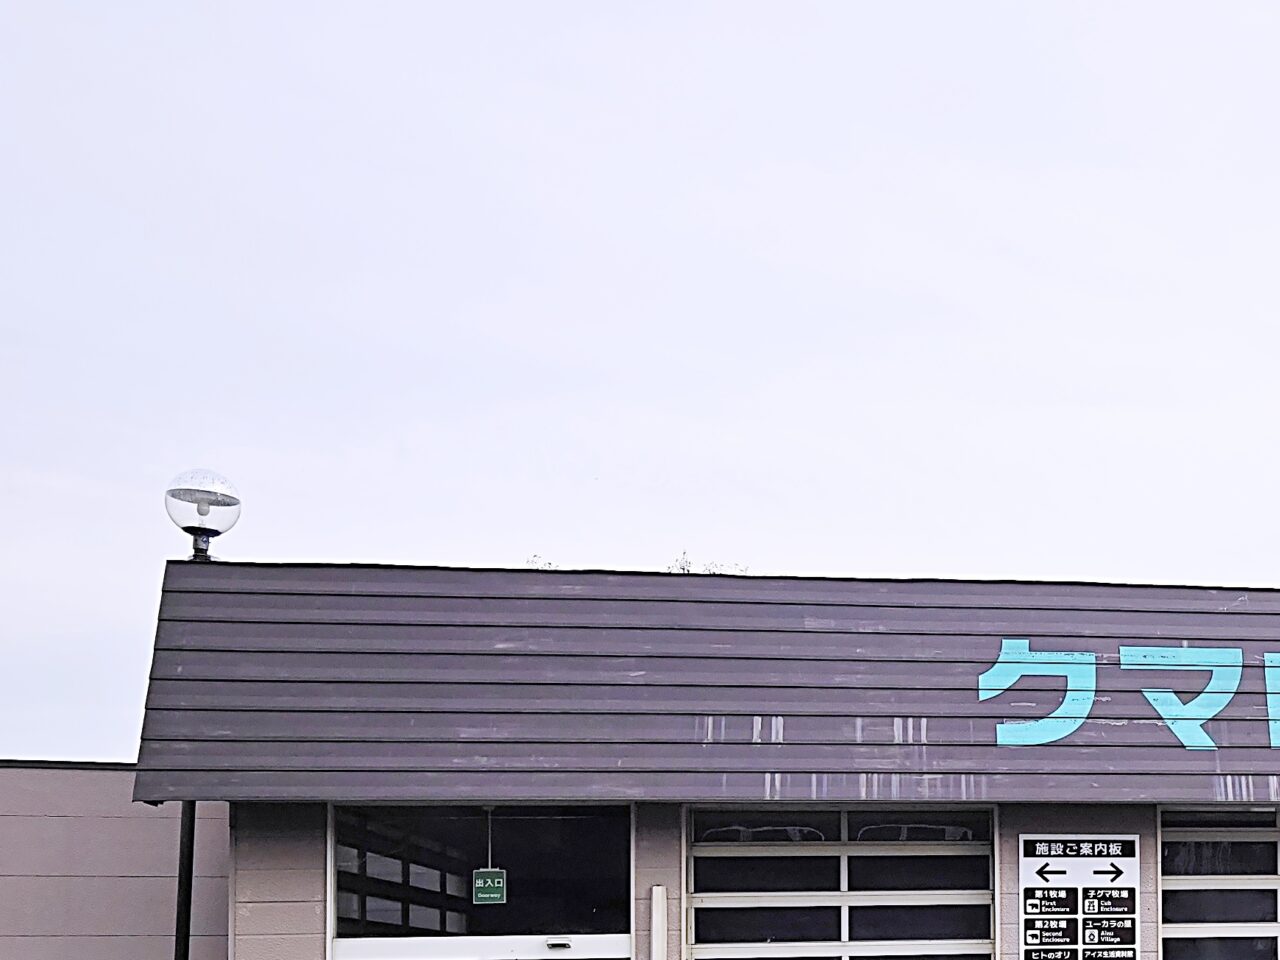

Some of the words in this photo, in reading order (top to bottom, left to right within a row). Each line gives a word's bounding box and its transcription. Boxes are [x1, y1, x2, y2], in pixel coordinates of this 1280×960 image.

[1035, 842, 1122, 856] 施設ご案内板
[475, 878, 503, 888] 出入口
[1087, 889, 1129, 899] 子グマ牧場
[1031, 951, 1071, 960] ヒトのオリ
